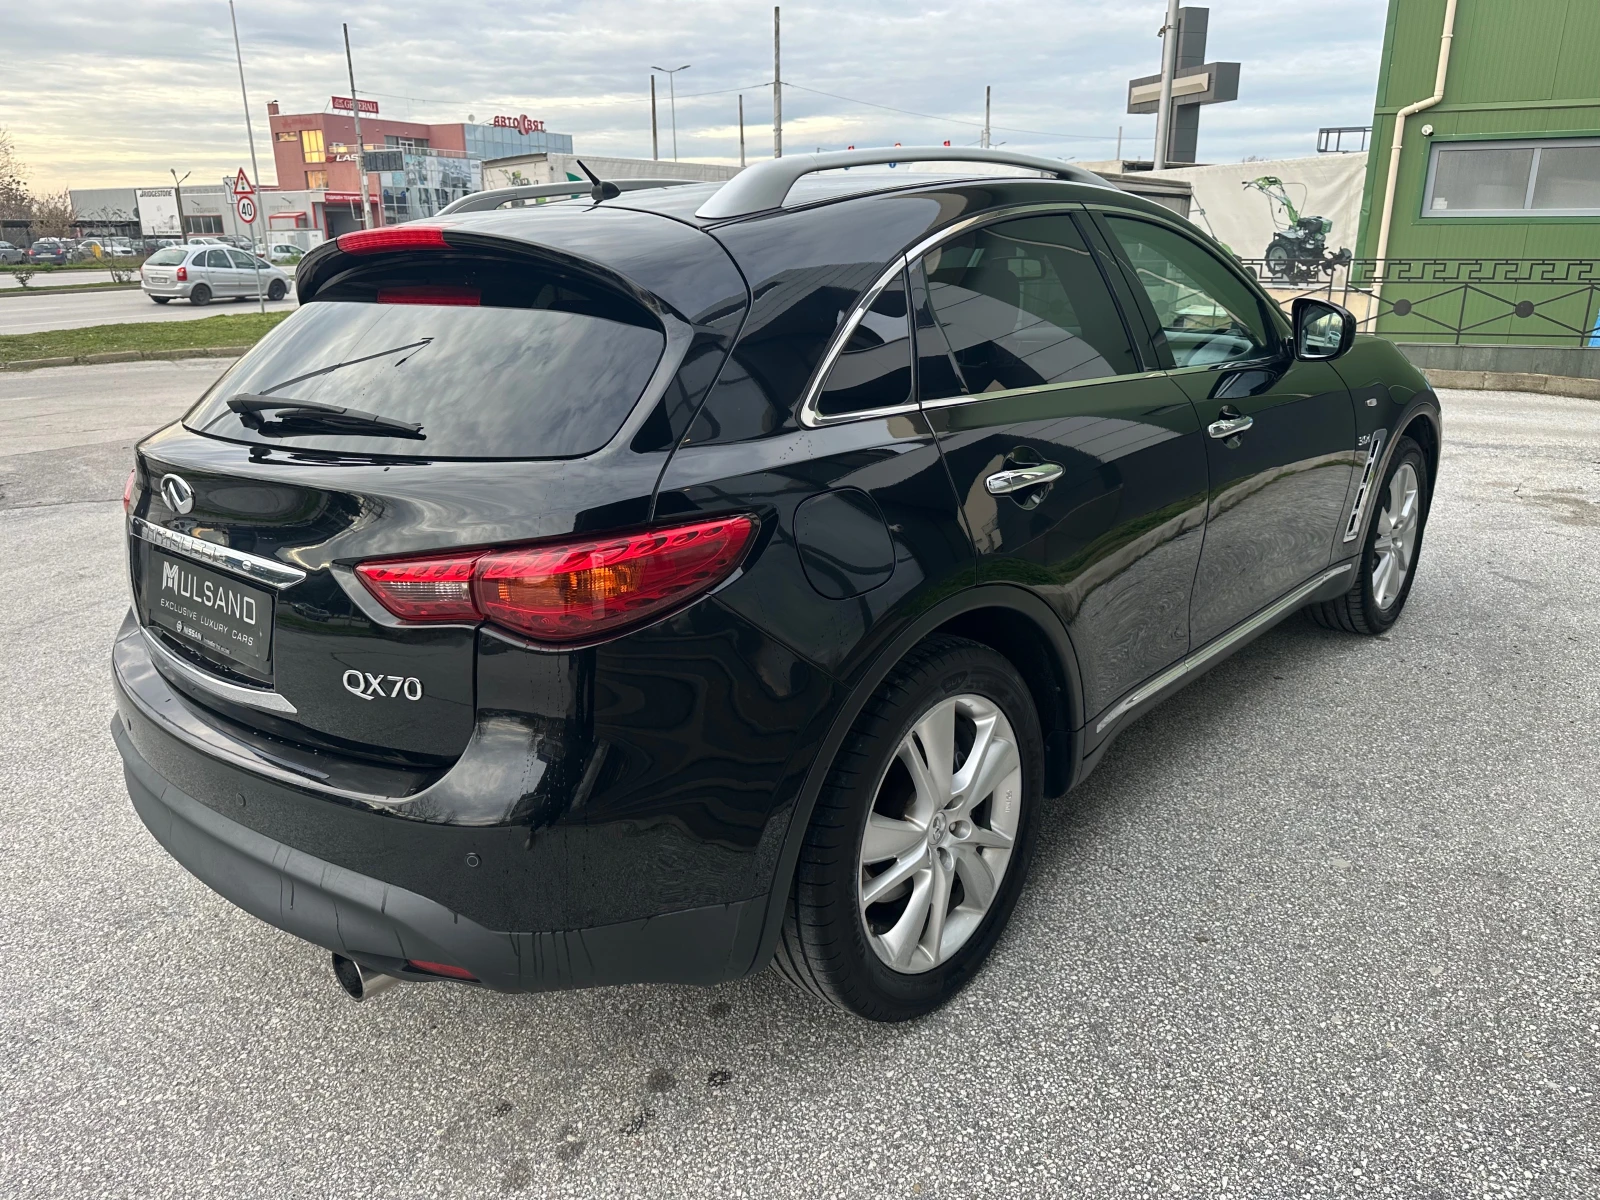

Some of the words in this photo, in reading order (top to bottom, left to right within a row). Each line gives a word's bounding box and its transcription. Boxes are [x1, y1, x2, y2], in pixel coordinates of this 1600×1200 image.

[343, 99, 377, 112] GEERALI
[241, 203, 253, 217] 40
[160, 598, 198, 621] EXCLUSIVE
[200, 615, 229, 634] LUXURY
[231, 629, 254, 646] CARS
[183, 625, 202, 641] NISSAN
[342, 669, 422, 700] QX70
